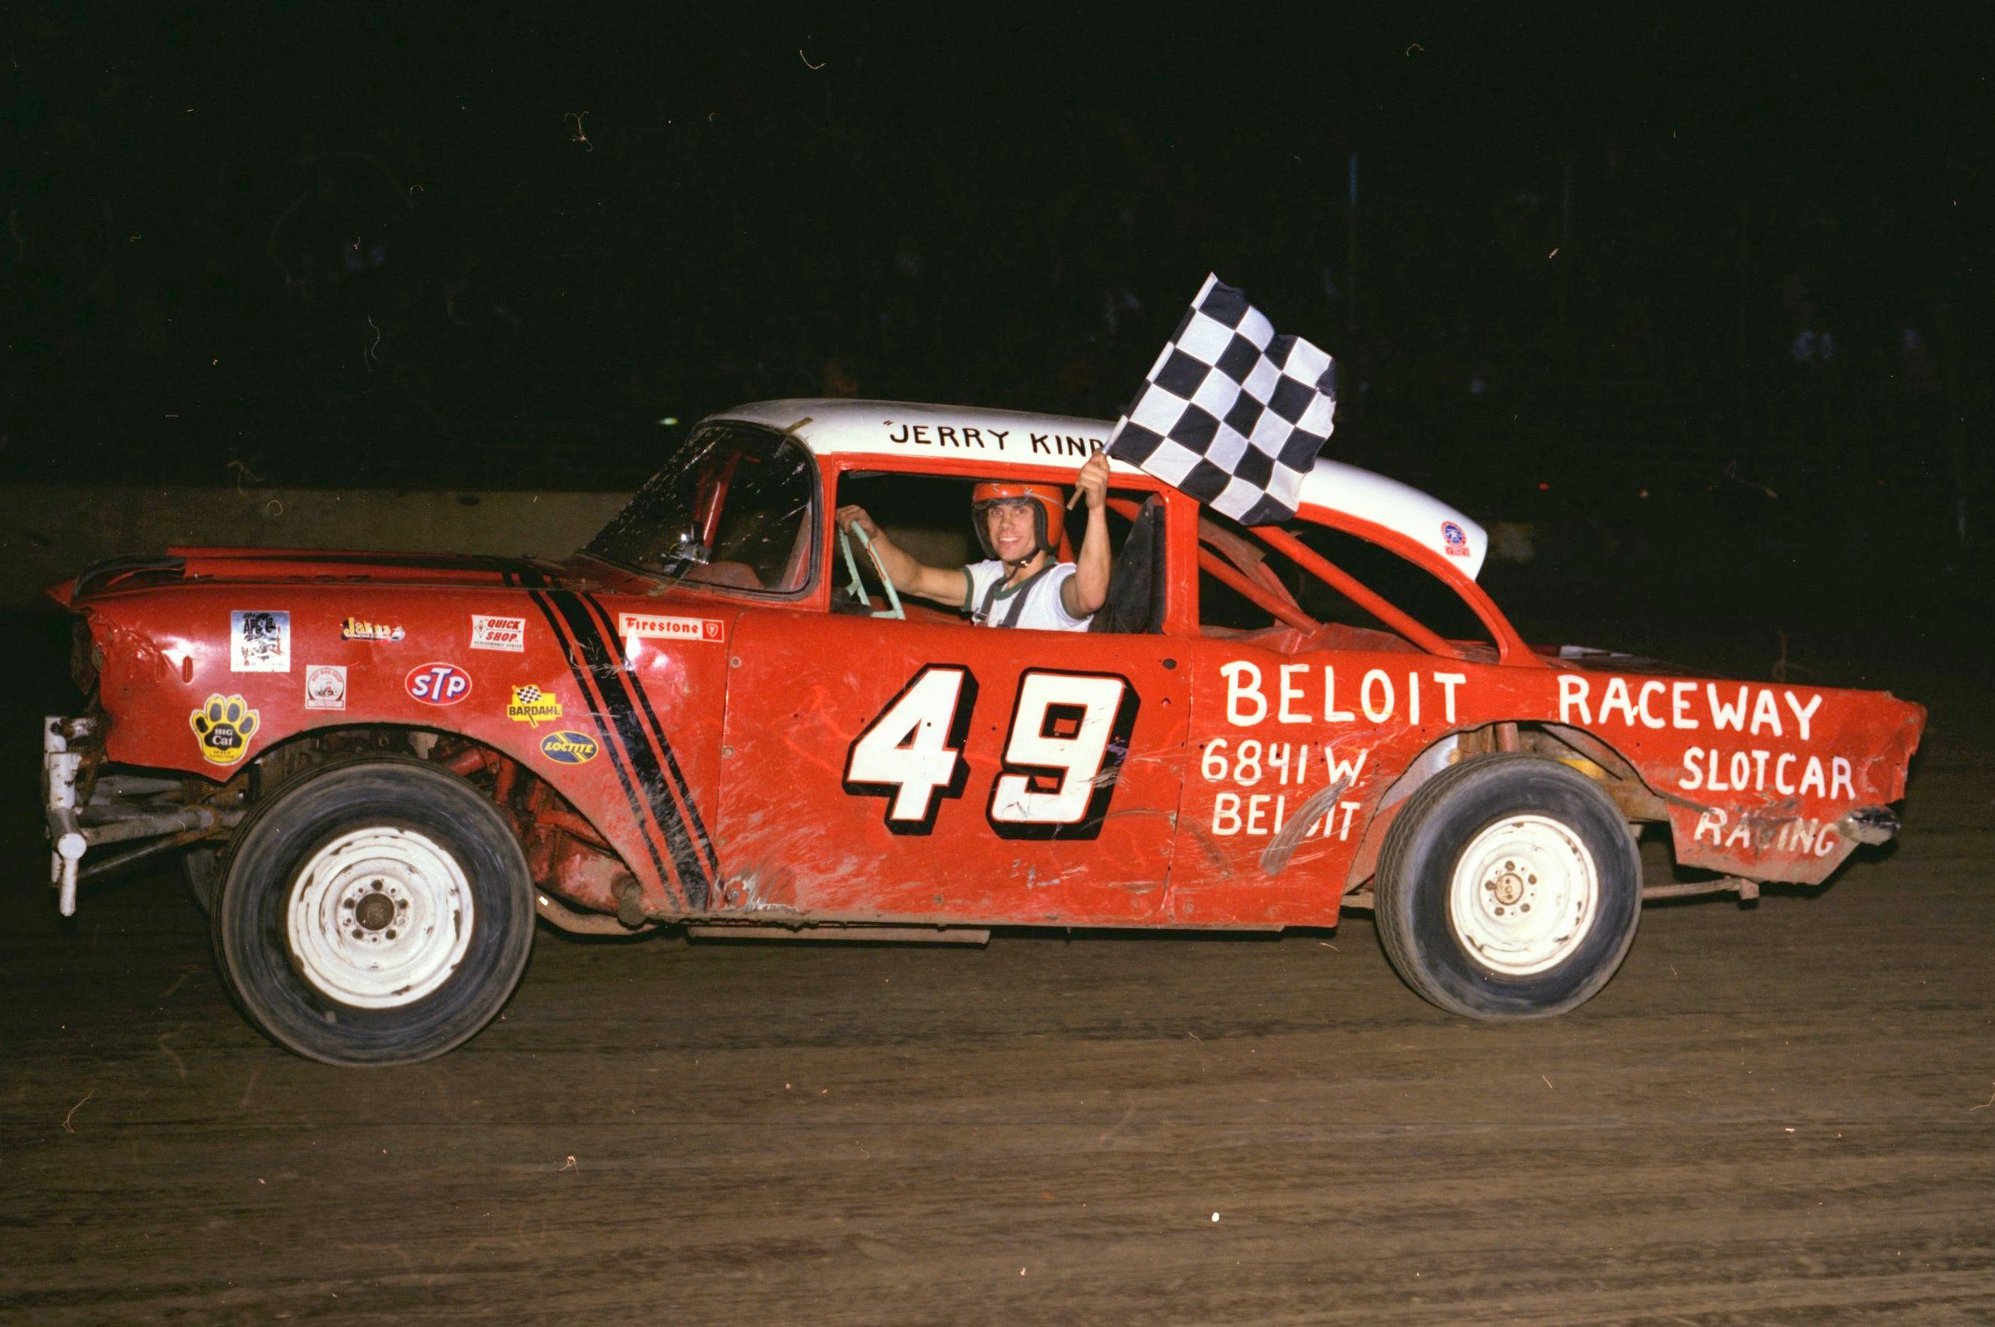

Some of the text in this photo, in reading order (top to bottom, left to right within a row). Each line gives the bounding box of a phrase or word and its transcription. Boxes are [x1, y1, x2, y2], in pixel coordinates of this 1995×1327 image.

[487, 618, 521, 630] QUICK
[625, 617, 699, 634] Firestone
[485, 631, 518, 642] SHOP
[411, 667, 466, 700] STP
[1219, 660, 1823, 741] BELOIT RACEWAY
[508, 706, 560, 716] BARDAHL
[214, 728, 233, 736] BIG
[212, 735, 233, 746] Cat
[544, 741, 594, 753] LOCTITE
[842, 662, 1142, 840] 49
[1201, 738, 1309, 787] 6841
